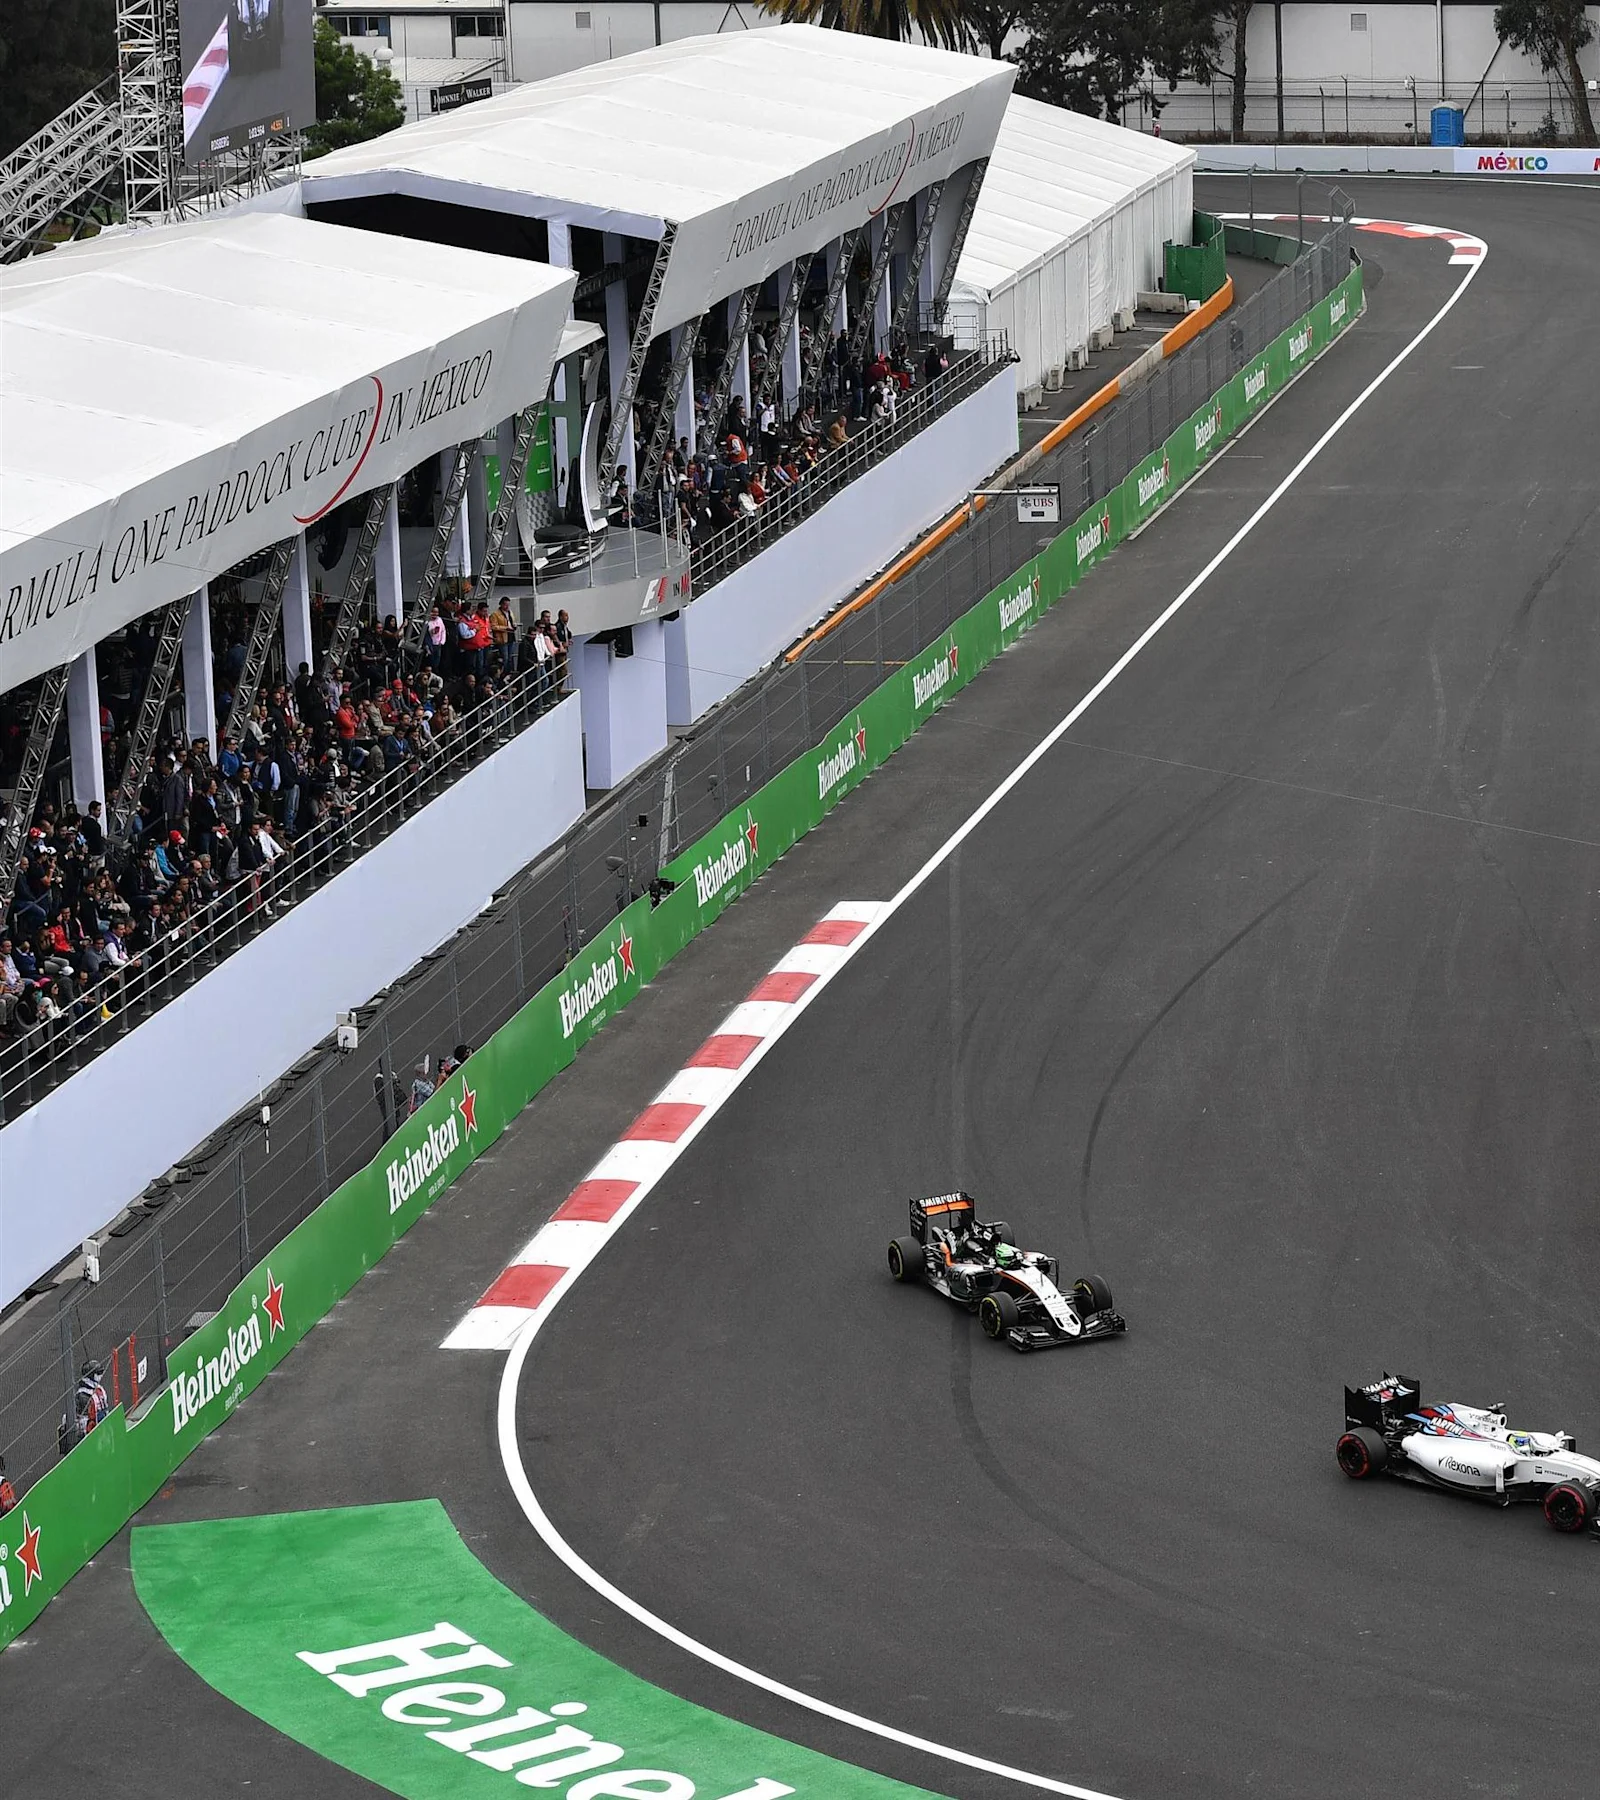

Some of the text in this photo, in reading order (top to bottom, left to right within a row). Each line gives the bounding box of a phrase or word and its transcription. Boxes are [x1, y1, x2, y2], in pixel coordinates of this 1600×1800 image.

[466, 86, 491, 99] WALKER
[727, 200, 790, 262] FORMULA
[792, 184, 823, 230] ONE
[821, 160, 875, 217] PADDOCK
[909, 127, 929, 168] IN
[0, 540, 104, 644] RMULA
[111, 505, 176, 586] ONE
[175, 443, 297, 552] PADDOCK
[380, 390, 410, 445] IN
[409, 348, 493, 431] MÉXICO
[1033, 498, 1054, 507] UBS
[999, 582, 1033, 632] Heineken
[912, 655, 950, 710] Heineken
[817, 741, 856, 800] Heineken
[693, 838, 747, 908] Heineken
[558, 955, 618, 1039] Heineken
[386, 1112, 460, 1215] Heineken
[169, 1313, 262, 1435] Heineken
[1430, 1416, 1465, 1436] MARTINI
[1445, 1456, 1481, 1477] Rexona
